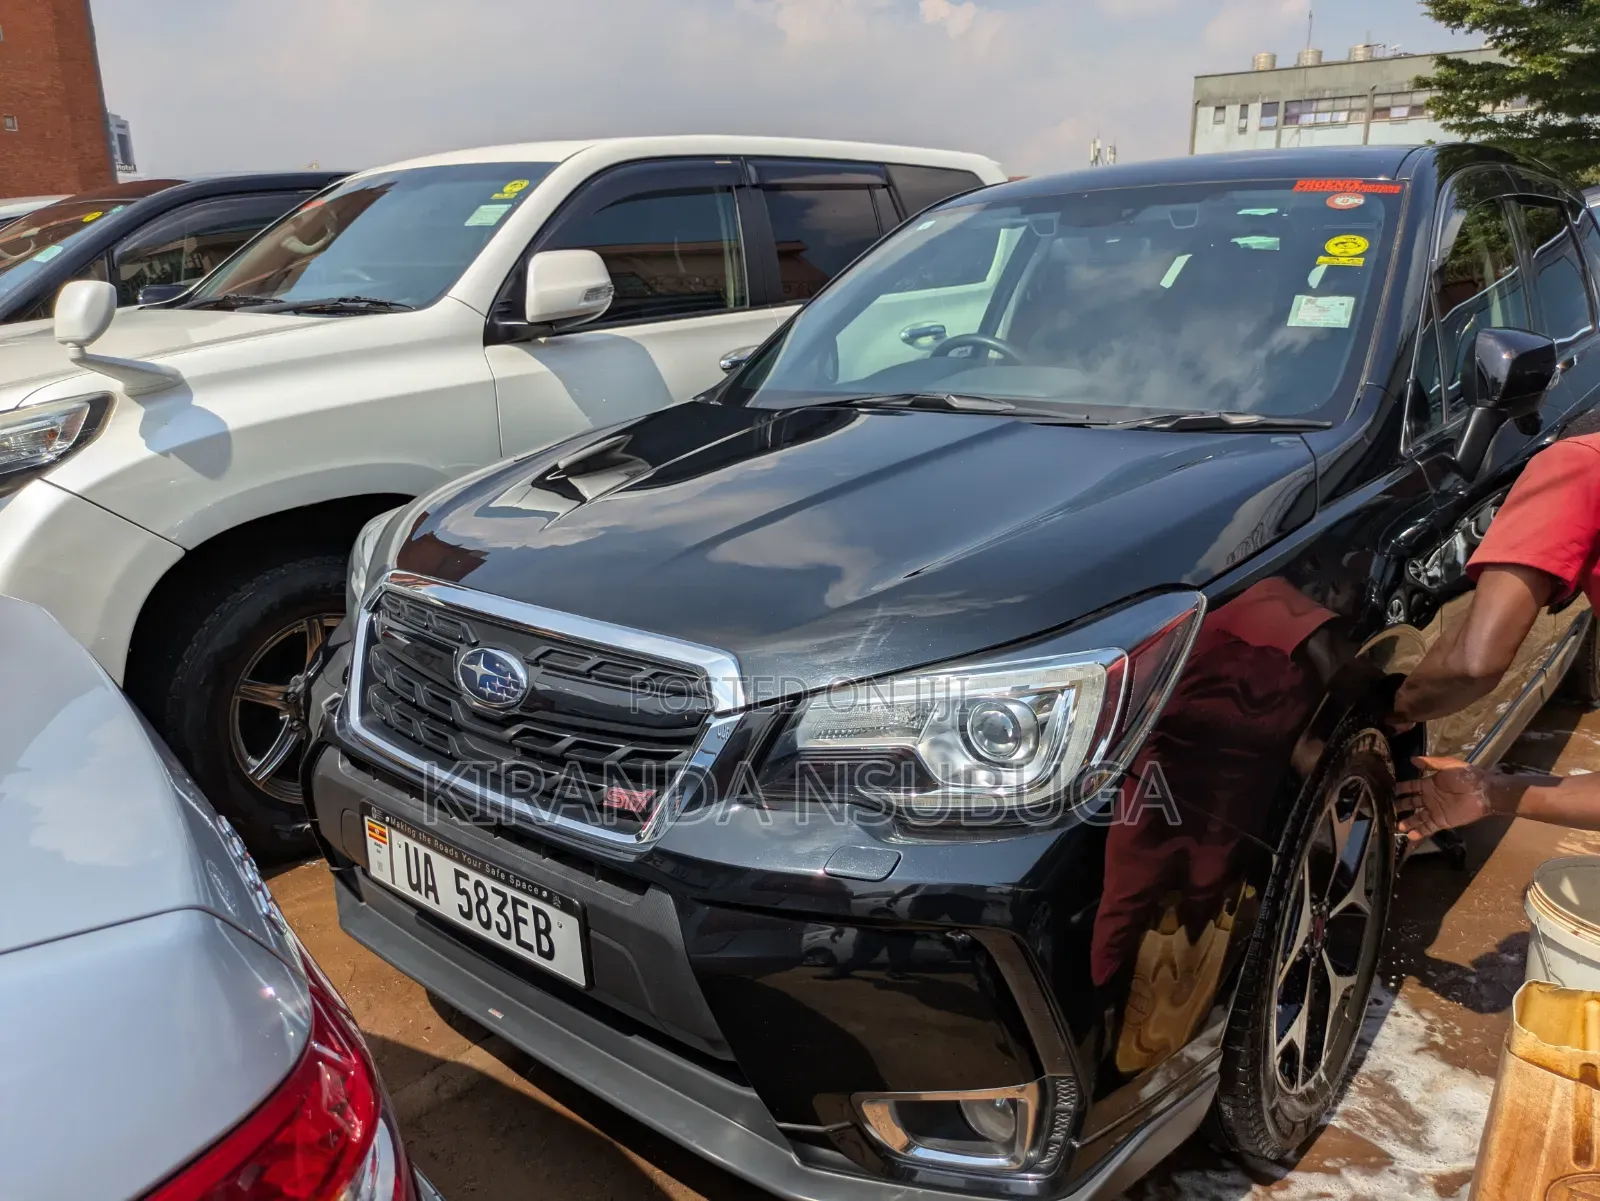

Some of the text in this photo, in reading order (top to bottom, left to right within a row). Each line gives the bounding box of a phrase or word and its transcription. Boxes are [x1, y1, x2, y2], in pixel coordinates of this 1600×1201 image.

[390, 816, 539, 895] Making the Roads Your Safe Space
[404, 841, 555, 961] UA 583EB
